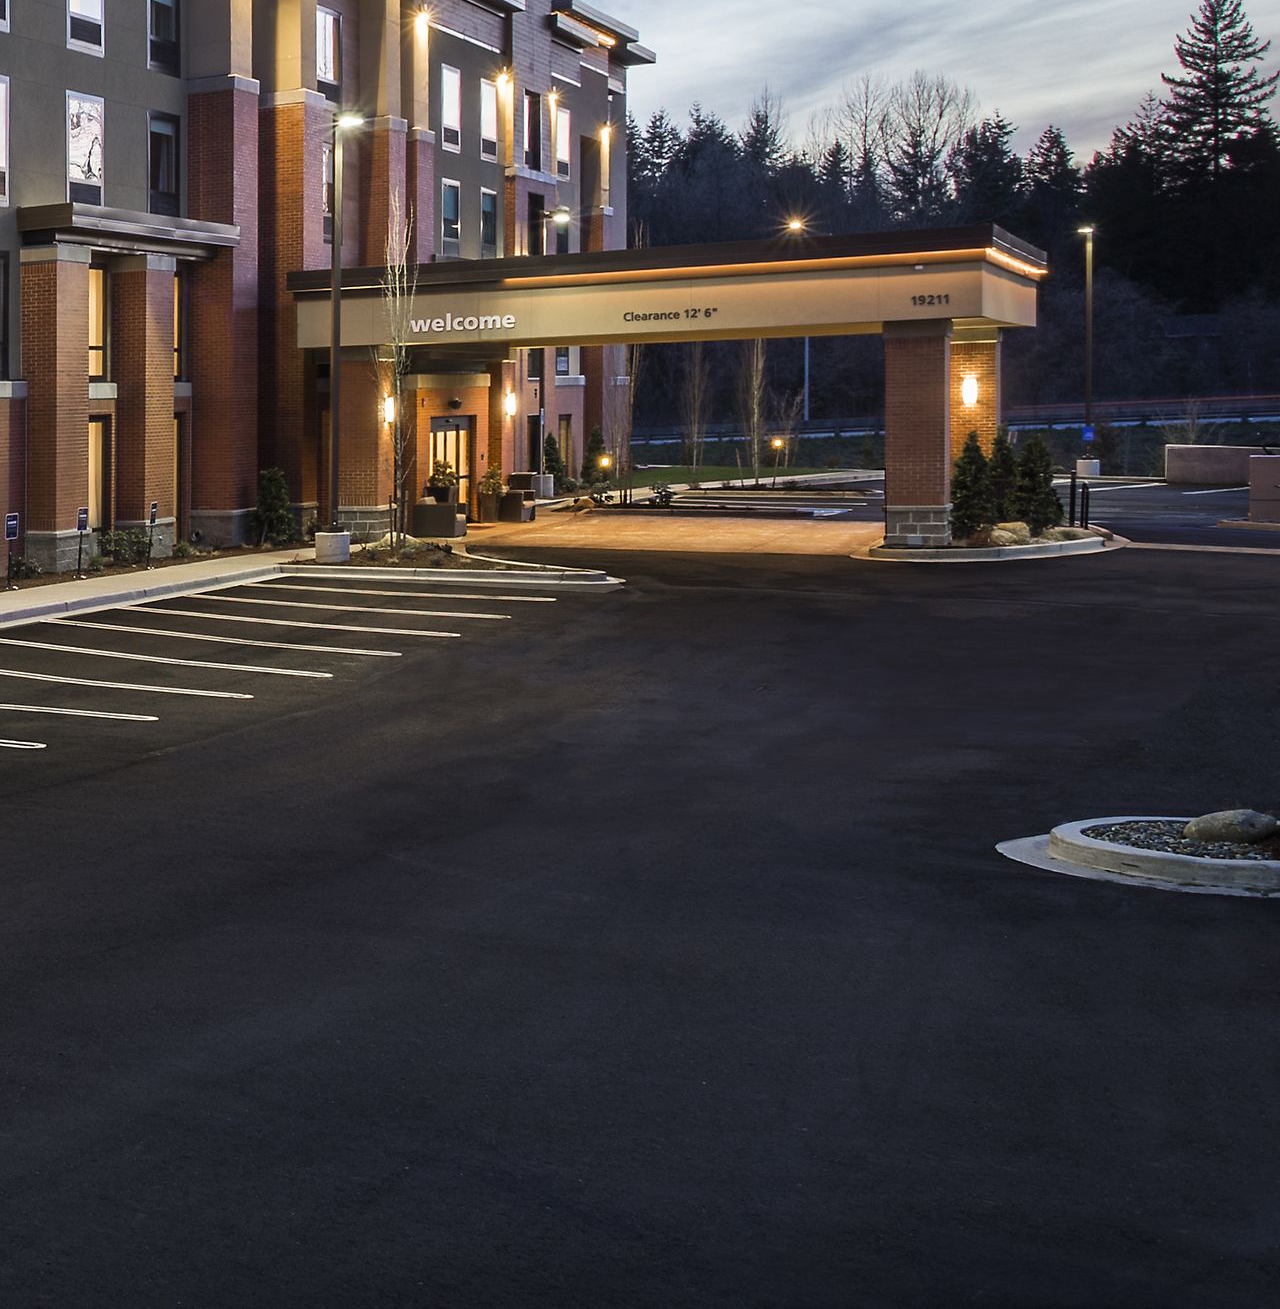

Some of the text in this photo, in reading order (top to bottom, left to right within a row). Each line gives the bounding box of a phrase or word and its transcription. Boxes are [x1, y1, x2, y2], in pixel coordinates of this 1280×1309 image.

[911, 294, 950, 306] 19211
[623, 307, 718, 322] Clearance 12' 6"
[410, 313, 516, 333] welcome
